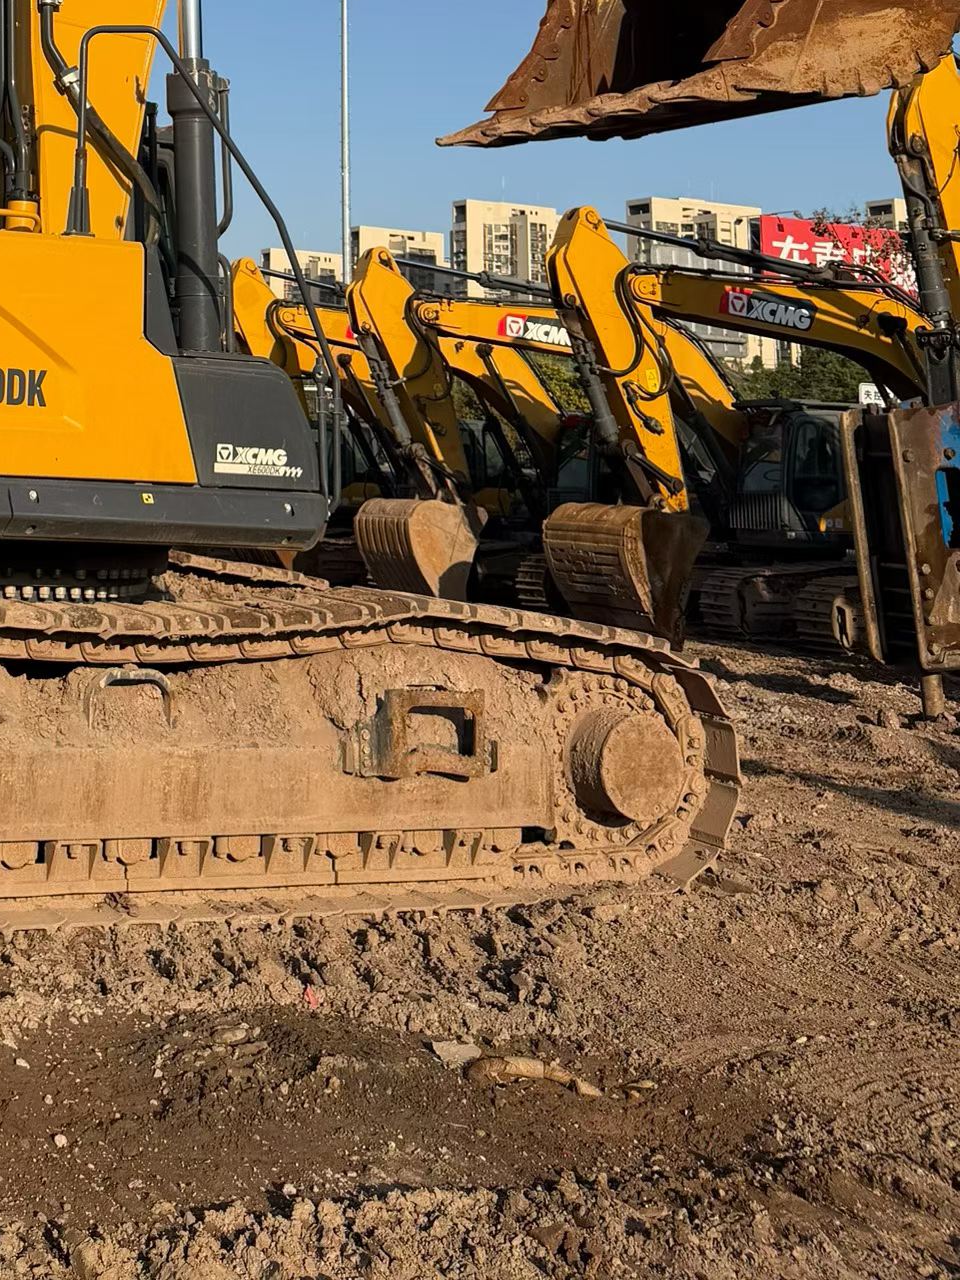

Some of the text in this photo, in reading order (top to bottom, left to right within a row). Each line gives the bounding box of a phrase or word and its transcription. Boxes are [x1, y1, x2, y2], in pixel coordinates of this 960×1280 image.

[746, 298, 811, 330] XCMG
[522, 321, 572, 347] XCM
[233, 446, 288, 467] XCMG
